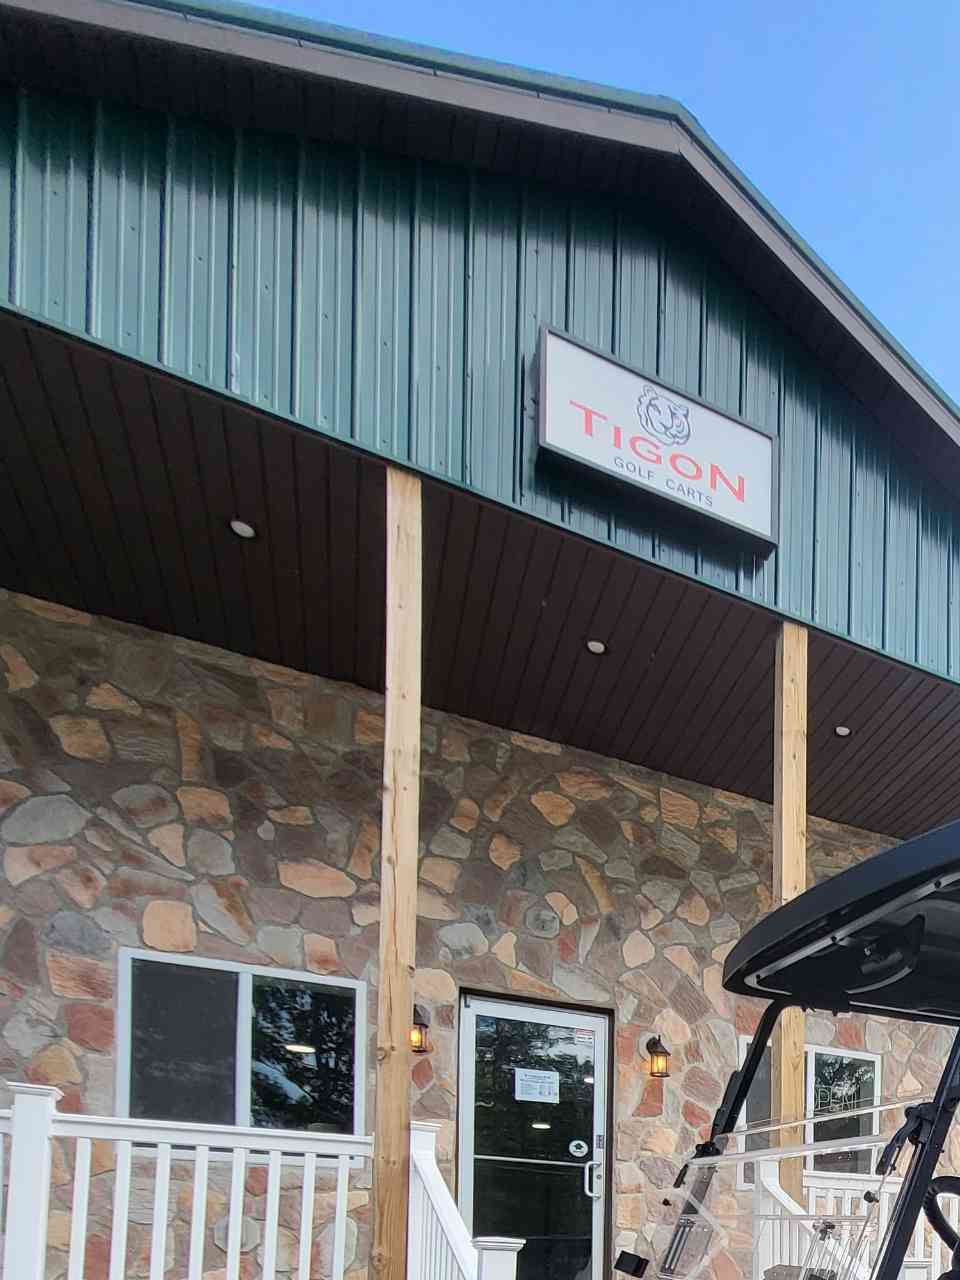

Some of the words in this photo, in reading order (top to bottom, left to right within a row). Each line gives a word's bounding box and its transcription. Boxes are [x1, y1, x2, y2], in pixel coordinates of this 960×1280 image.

[569, 399, 745, 502] TIGON
[613, 456, 656, 482] GOLF
[665, 478, 713, 507] CARTS
